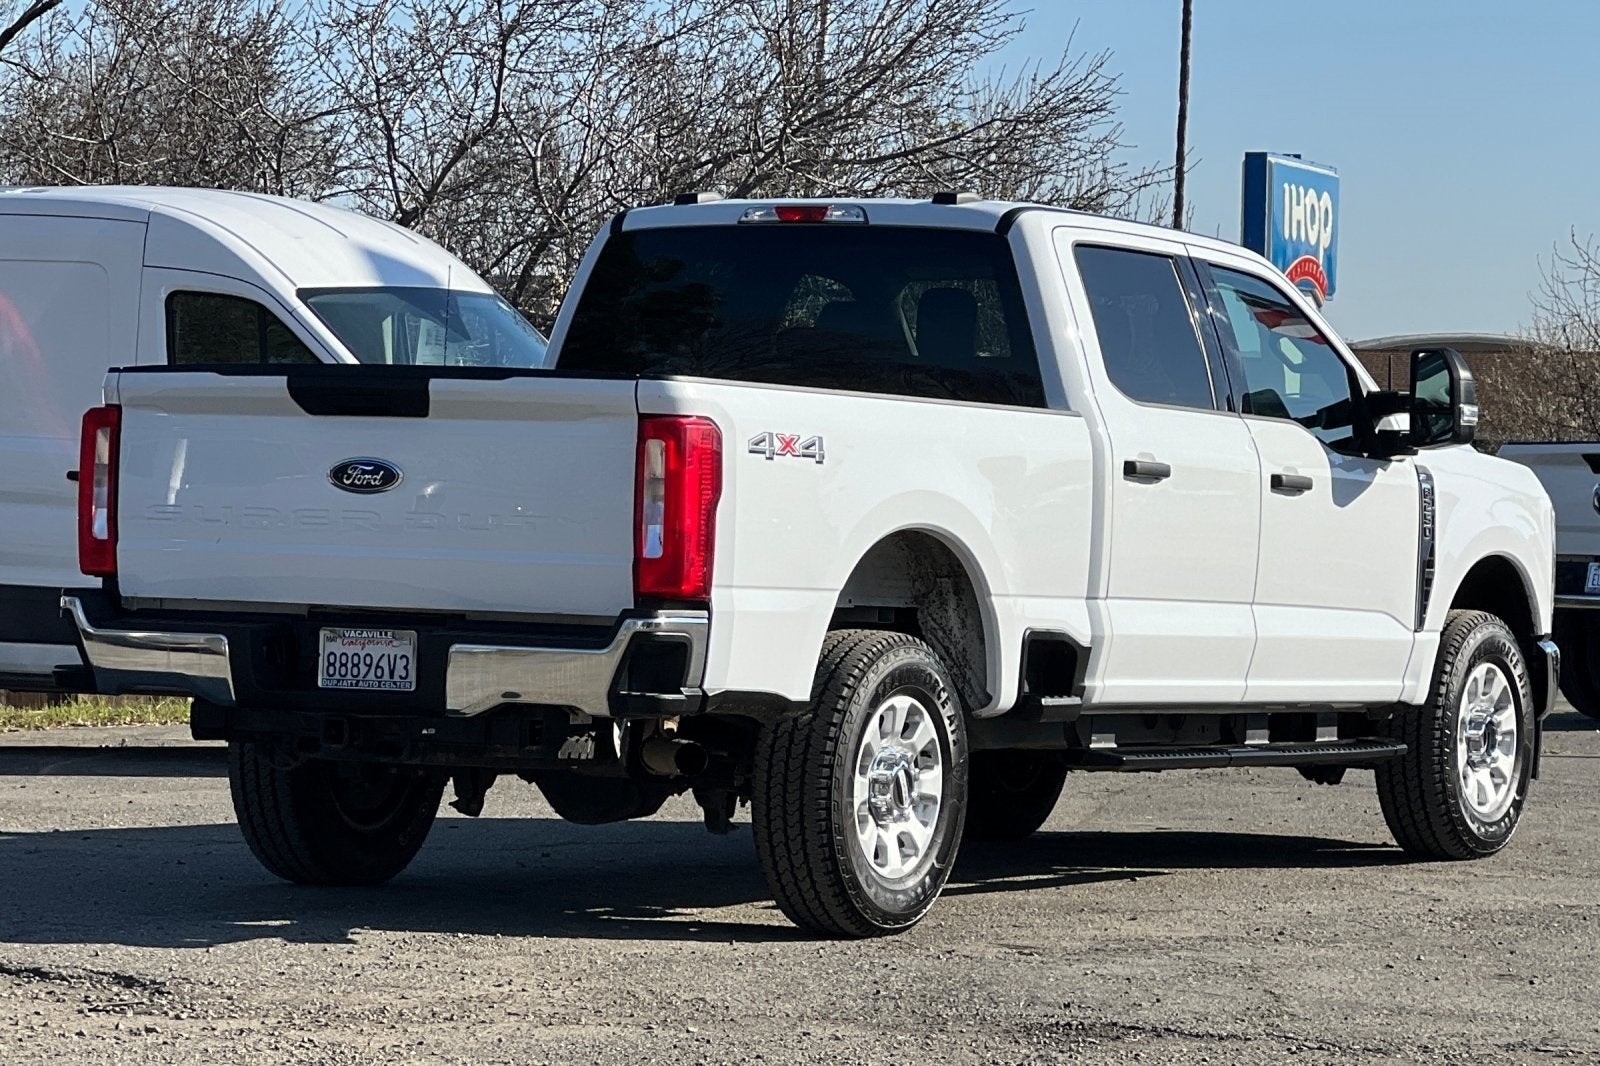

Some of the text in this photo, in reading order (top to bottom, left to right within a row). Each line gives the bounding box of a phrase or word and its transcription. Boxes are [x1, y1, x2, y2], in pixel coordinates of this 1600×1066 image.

[342, 463, 385, 486] Ford
[343, 630, 393, 639] VACAVILLE
[341, 638, 395, 651] California
[326, 651, 409, 680] 88896V3
[358, 679, 379, 688] AUTO
